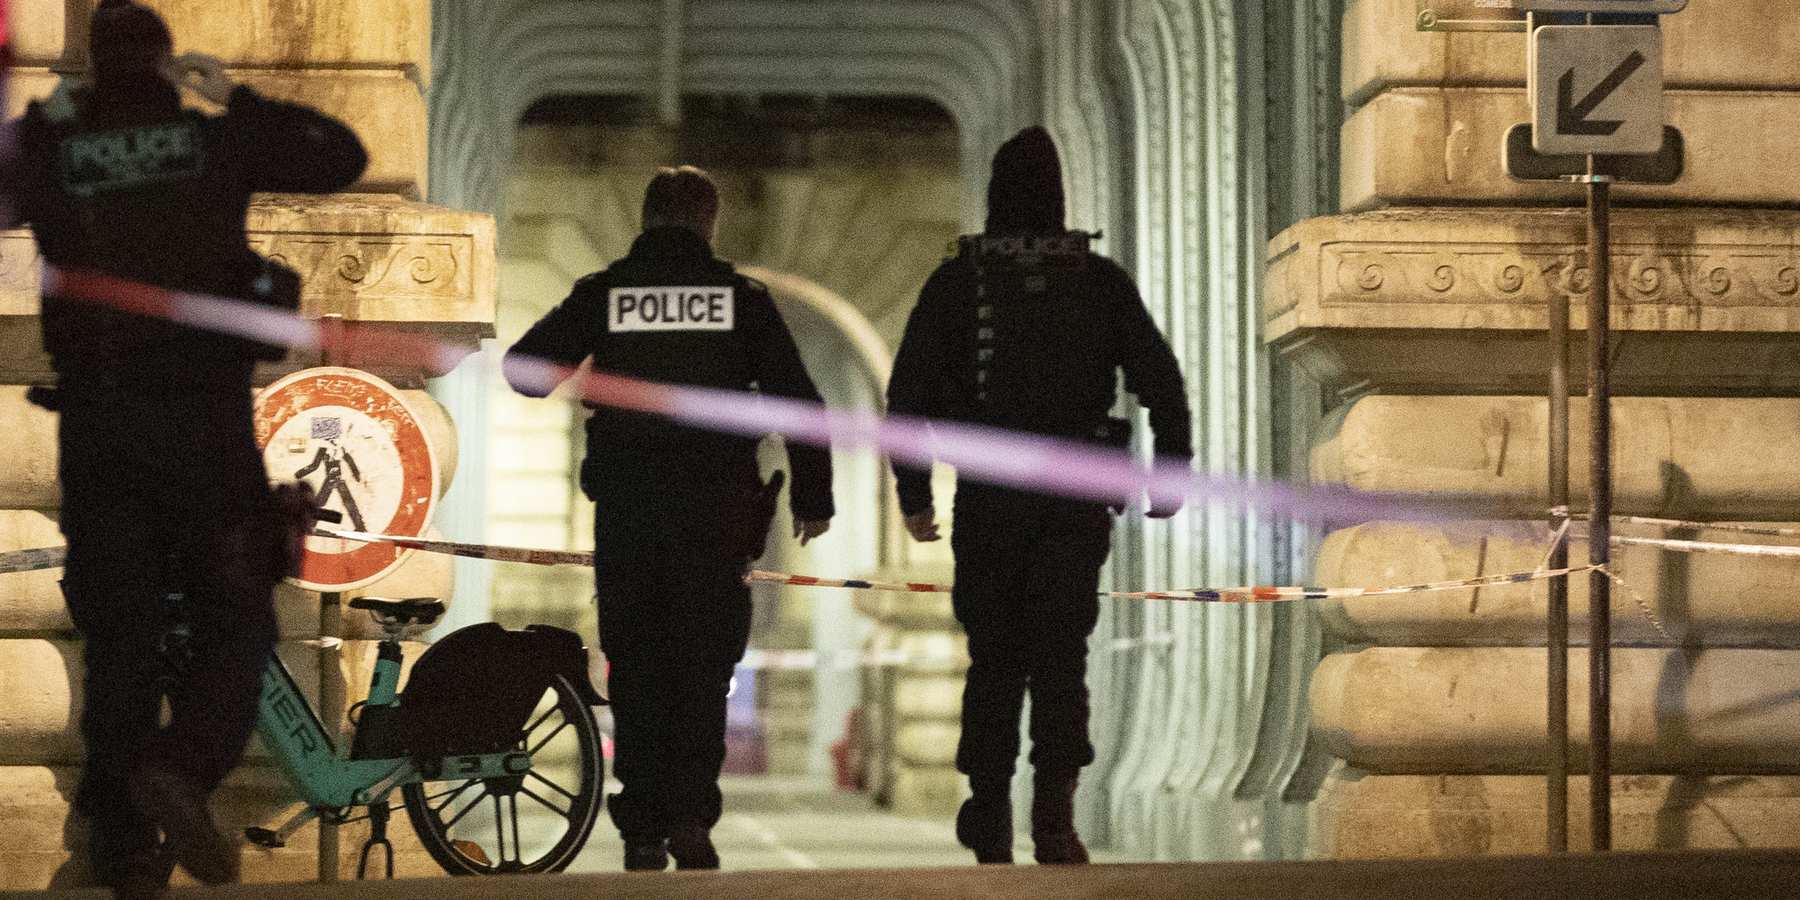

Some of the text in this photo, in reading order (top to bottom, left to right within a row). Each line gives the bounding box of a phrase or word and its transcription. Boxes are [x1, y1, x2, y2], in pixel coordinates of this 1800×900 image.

[71, 126, 194, 168] POLICE
[979, 237, 1078, 256] POLICE
[617, 293, 725, 324] POLICE
